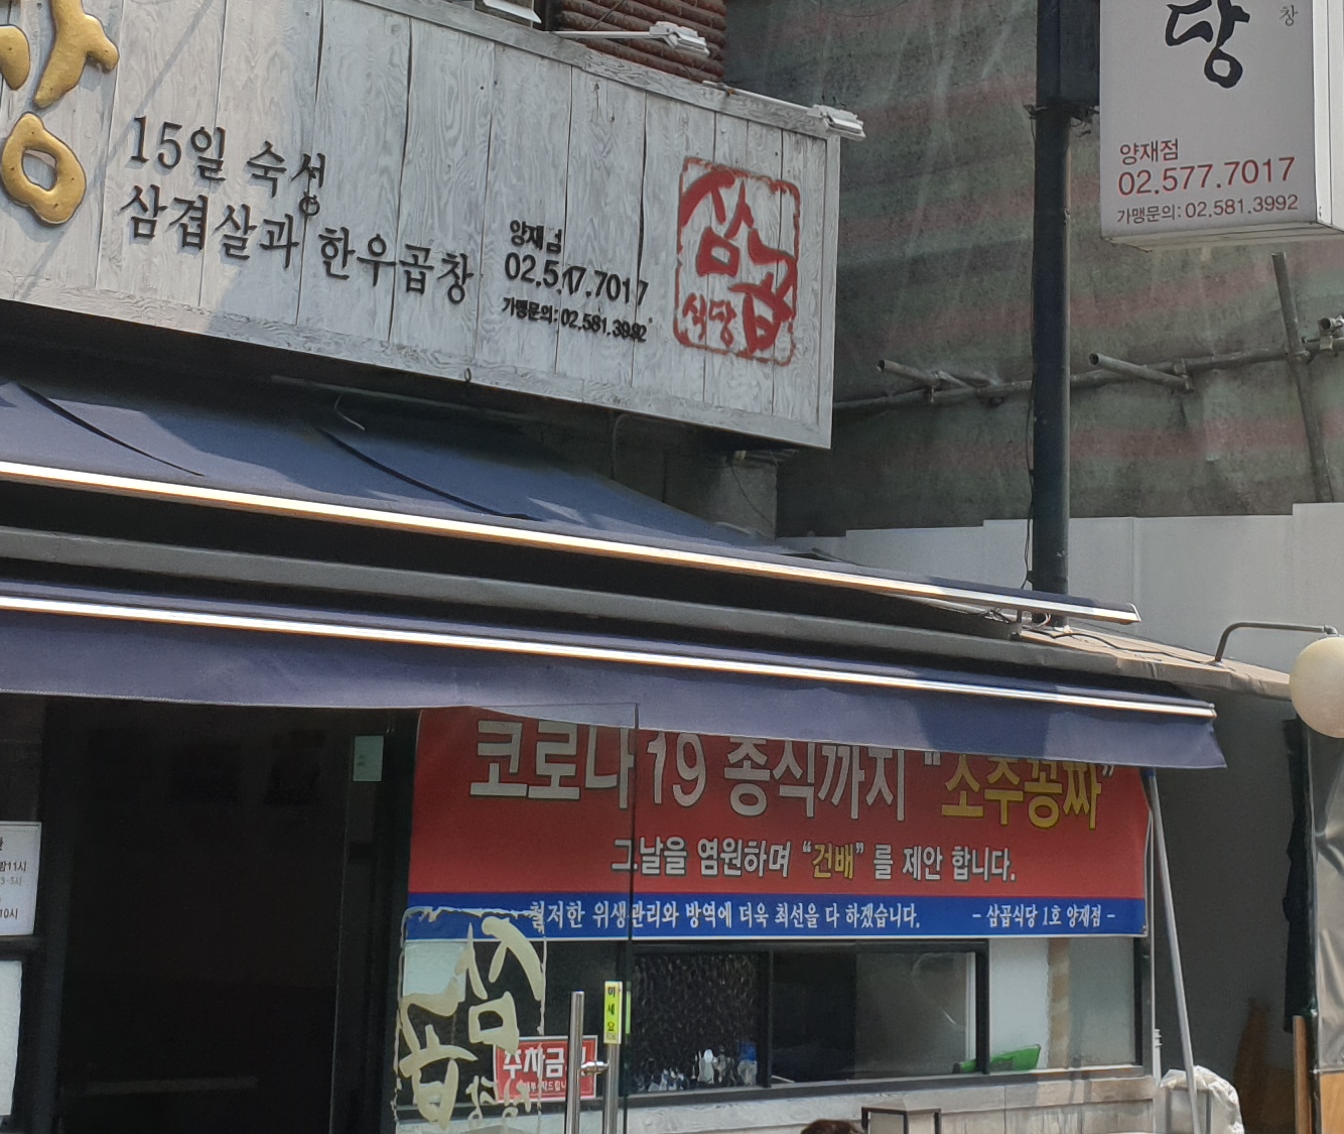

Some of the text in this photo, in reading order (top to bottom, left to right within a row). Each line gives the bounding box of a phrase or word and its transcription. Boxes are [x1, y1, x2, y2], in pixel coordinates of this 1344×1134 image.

[130, 116, 326, 217] 15일 숙성
[1120, 138, 1179, 165] 양재점
[1117, 156, 1296, 196] 02.577.7017
[1117, 194, 1298, 225] 가맹문의: 02.581.3992
[120, 184, 474, 306] 삼겹살과 한우곱창
[682, 292, 737, 347] 식당
[470, 720, 706, 809] 코로나19
[724, 736, 905, 821] 종식까지
[611, 836, 687, 877] 그날을
[697, 837, 792, 878] 염원하며
[902, 845, 943, 881] 제안
[951, 845, 1017, 882] 합니다.
[592, 900, 679, 929] 위생관리와
[685, 900, 732, 929] 방역에
[739, 902, 769, 929] 더욱
[774, 902, 819, 929] 최선을
[845, 903, 920, 930] 하겠습니다.
[986, 904, 1102, 928] 삼곱식당 1호 양재점
